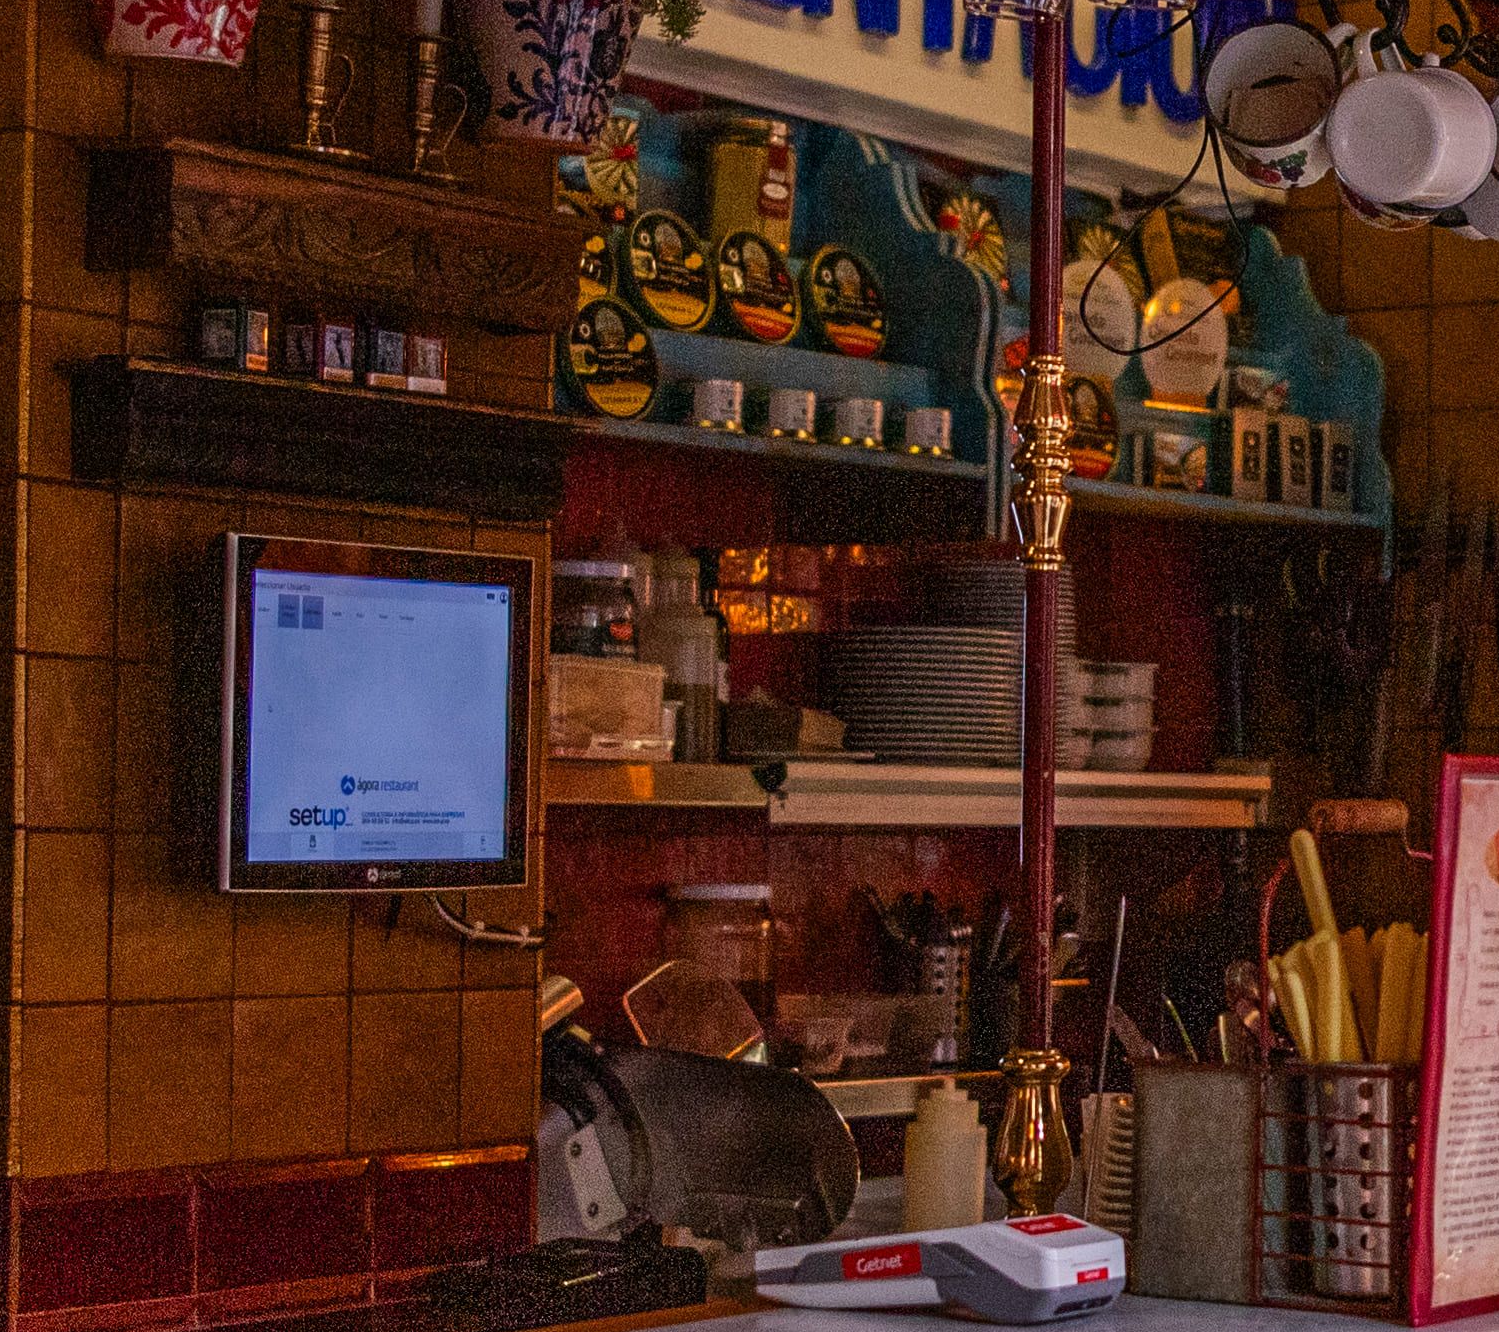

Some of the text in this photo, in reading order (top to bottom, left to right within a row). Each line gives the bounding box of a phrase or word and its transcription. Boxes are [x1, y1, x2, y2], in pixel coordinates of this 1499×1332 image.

[381, 780, 419, 792] restaurant
[289, 805, 347, 830] setup
[856, 1253, 904, 1275] Getnet
